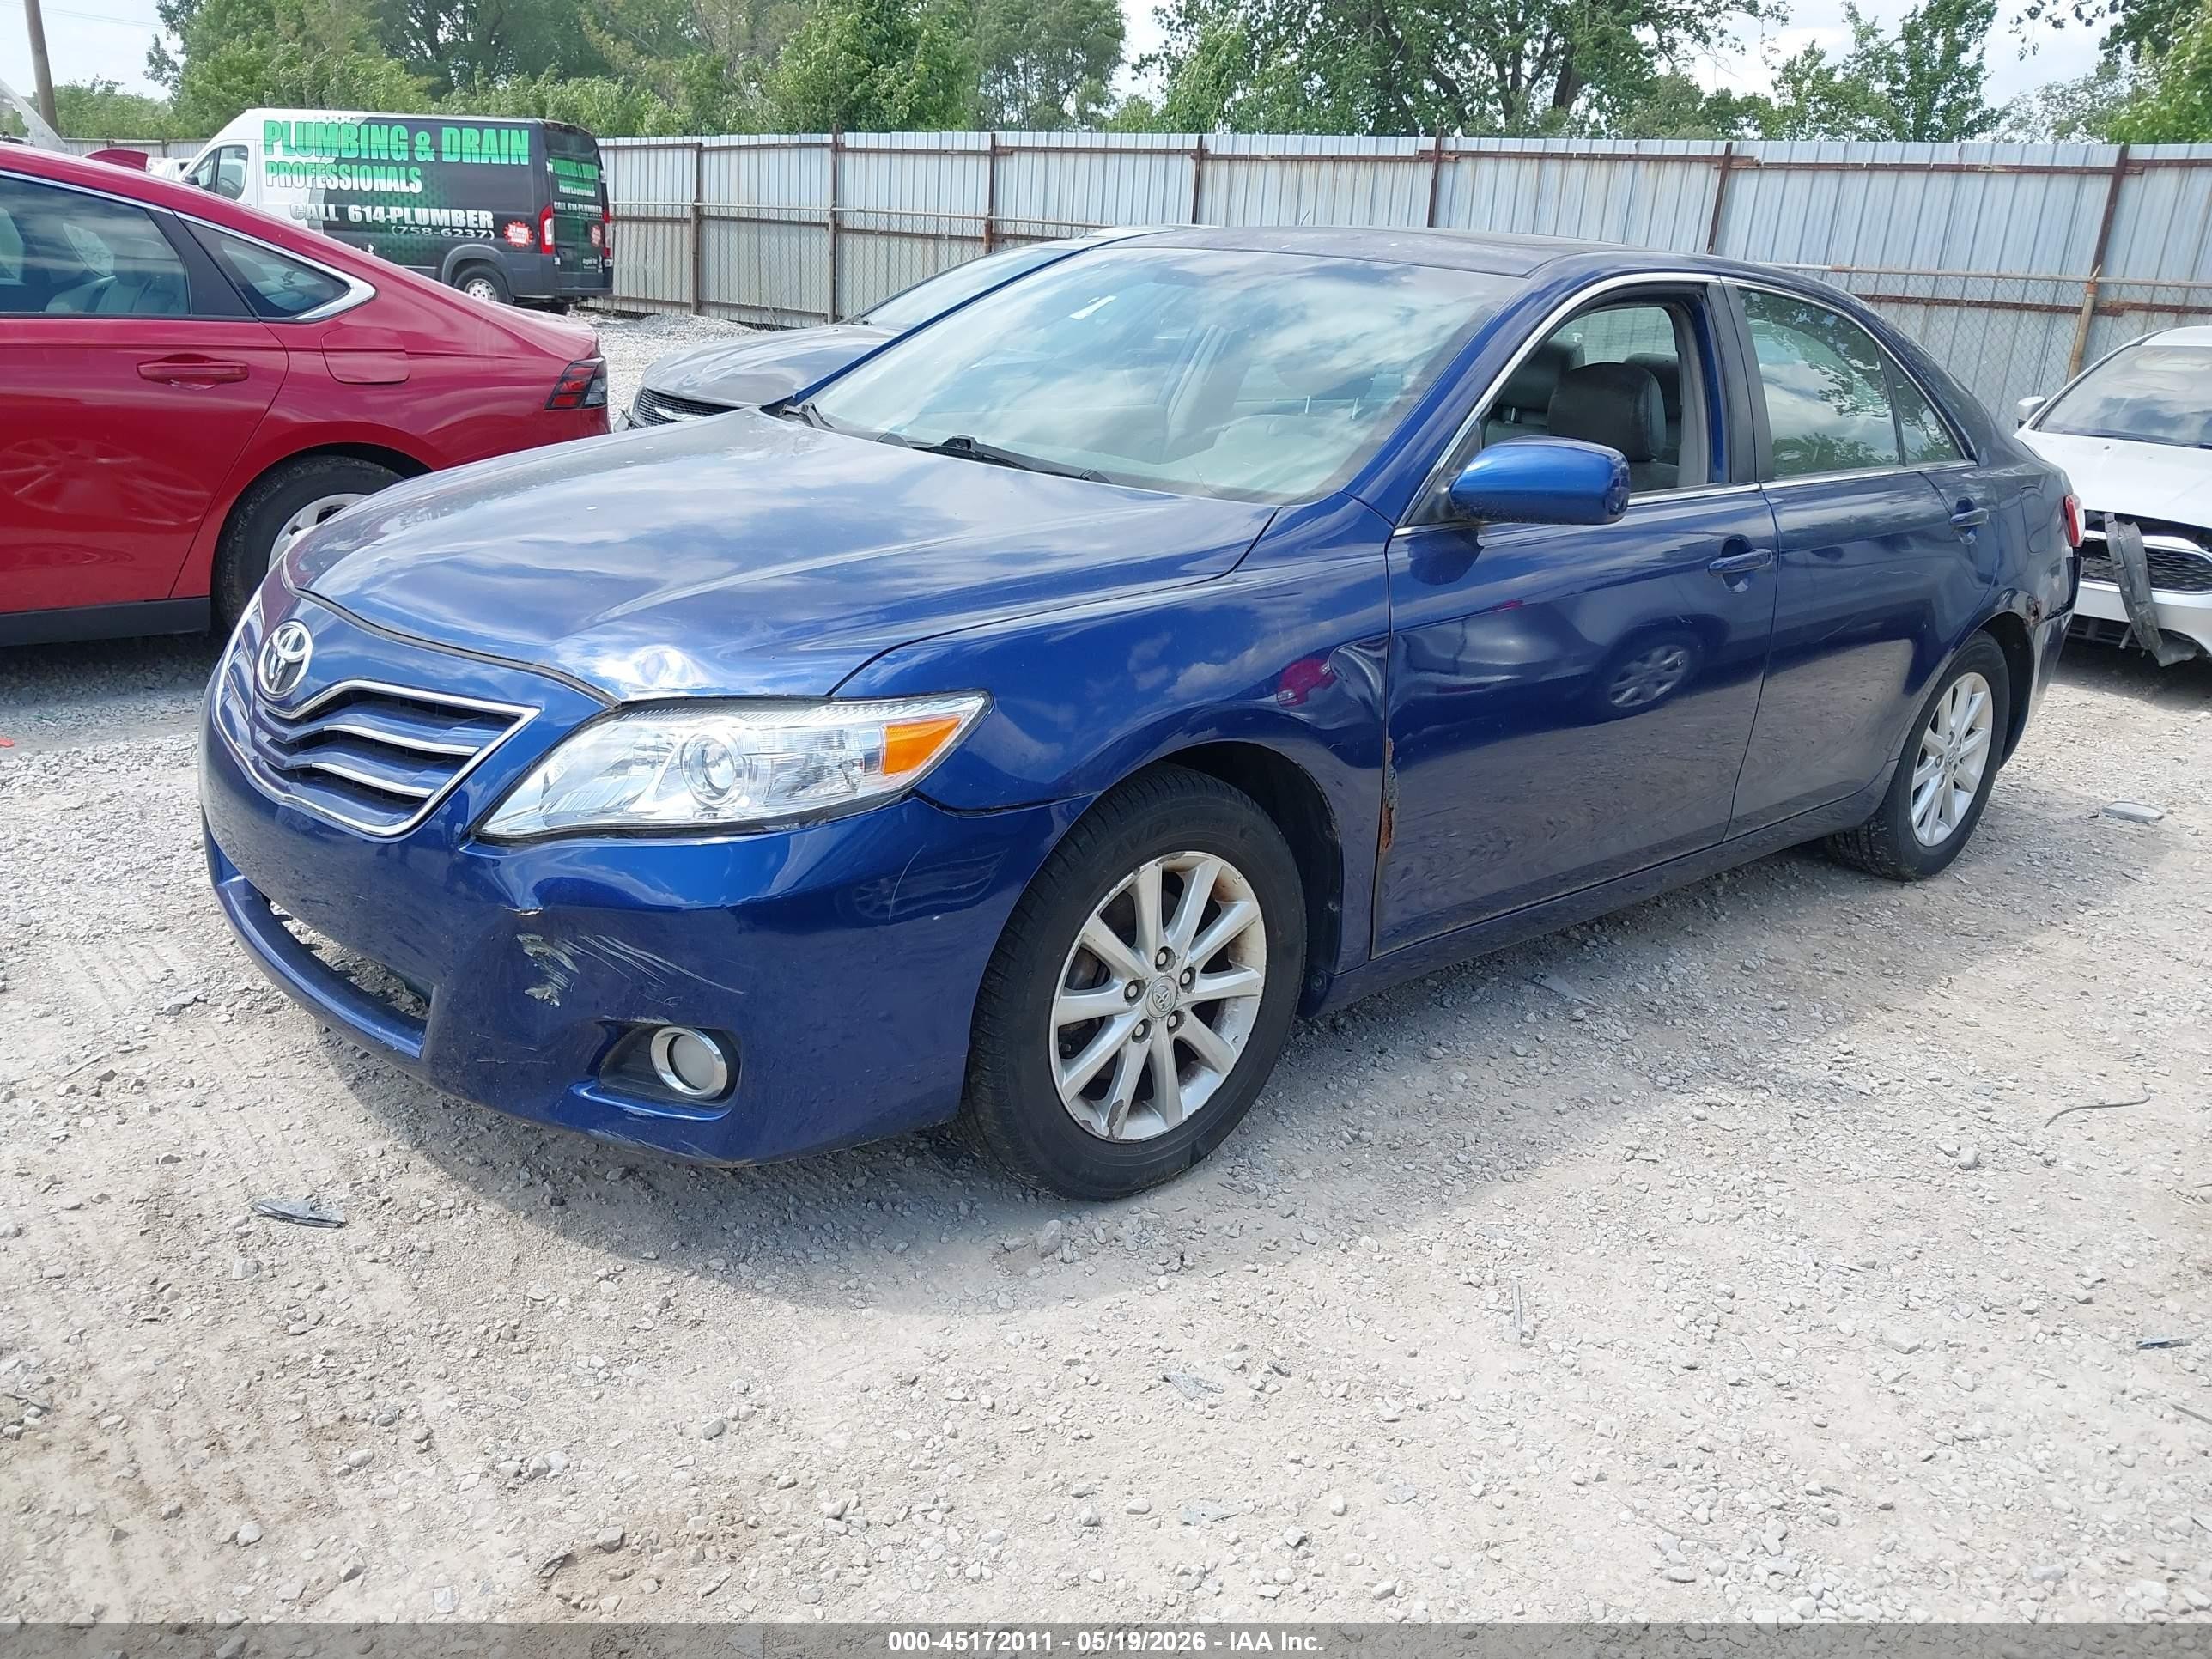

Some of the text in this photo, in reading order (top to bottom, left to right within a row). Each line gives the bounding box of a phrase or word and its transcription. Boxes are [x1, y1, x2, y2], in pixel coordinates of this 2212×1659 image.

[264, 120, 529, 165] PLUMBING & DRAIN
[265, 161, 422, 193] PROFESSIONALS
[290, 203, 495, 228] CALL 614-PLUMBER
[391, 225, 495, 240] (758-6237)
